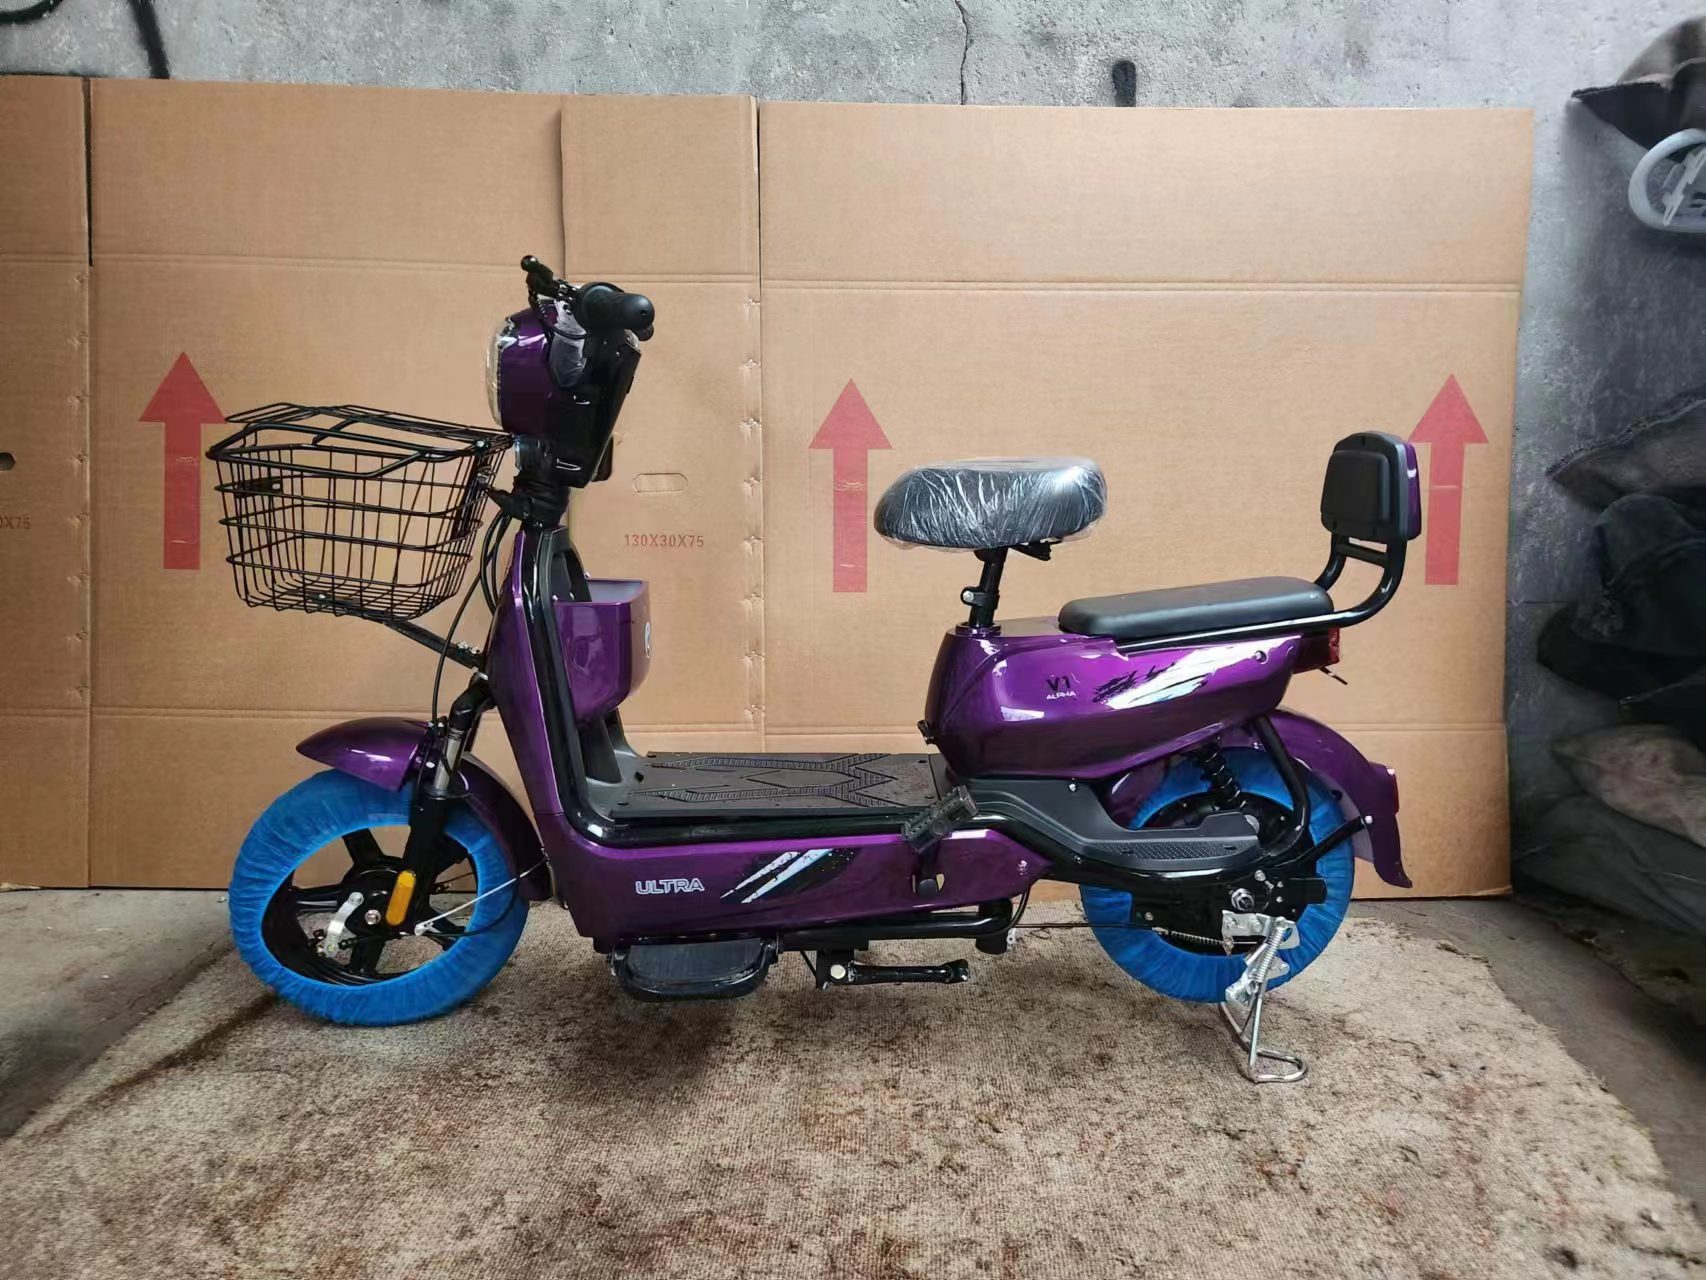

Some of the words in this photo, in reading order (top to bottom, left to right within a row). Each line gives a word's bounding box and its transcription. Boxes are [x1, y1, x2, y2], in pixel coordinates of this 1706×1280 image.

[624, 534, 704, 548] 130X30X75
[1046, 676, 1071, 692] V1
[1046, 690, 1077, 700] ALPHA
[635, 877, 705, 895] ULTRA
